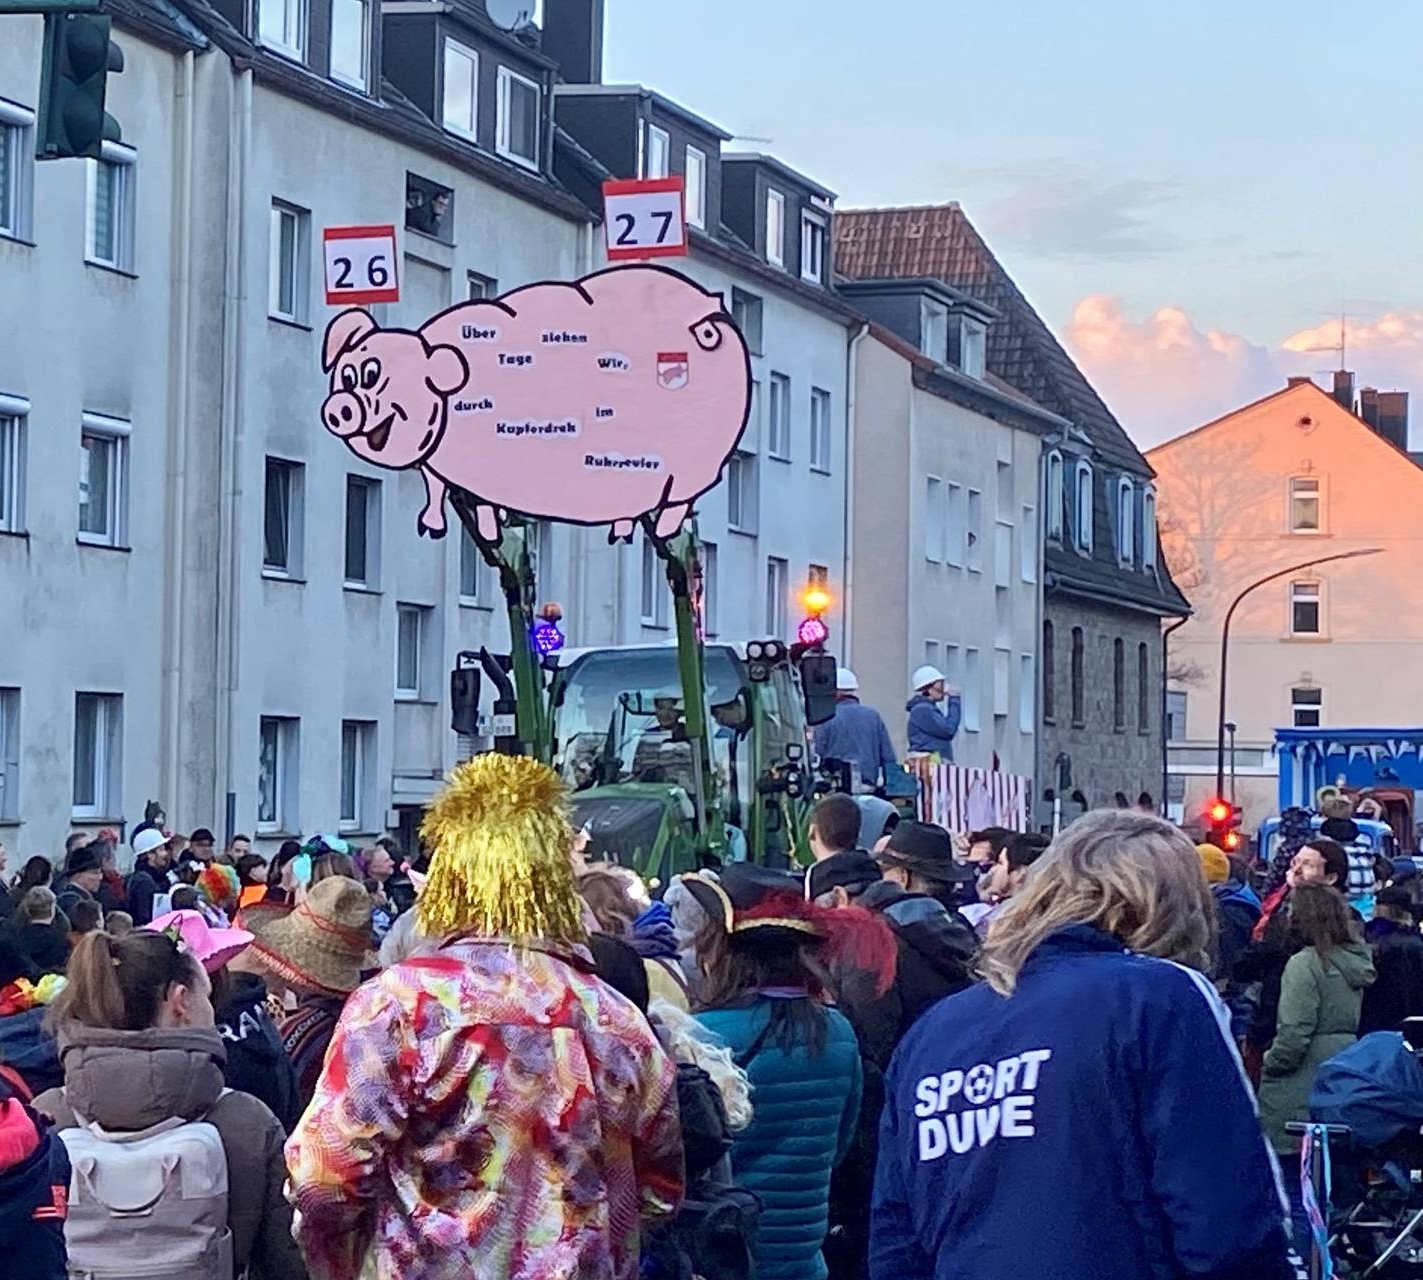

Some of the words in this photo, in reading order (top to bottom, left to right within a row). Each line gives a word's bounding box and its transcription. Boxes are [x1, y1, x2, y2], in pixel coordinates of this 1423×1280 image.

[461, 325, 496, 340] Über
[541, 331, 588, 343] ziehen
[498, 353, 533, 366] Tage
[454, 398, 493, 411] durch
[595, 406, 614, 418] im
[914, 1049, 1053, 1118] SPORT
[918, 1094, 1036, 1161] DUVE
